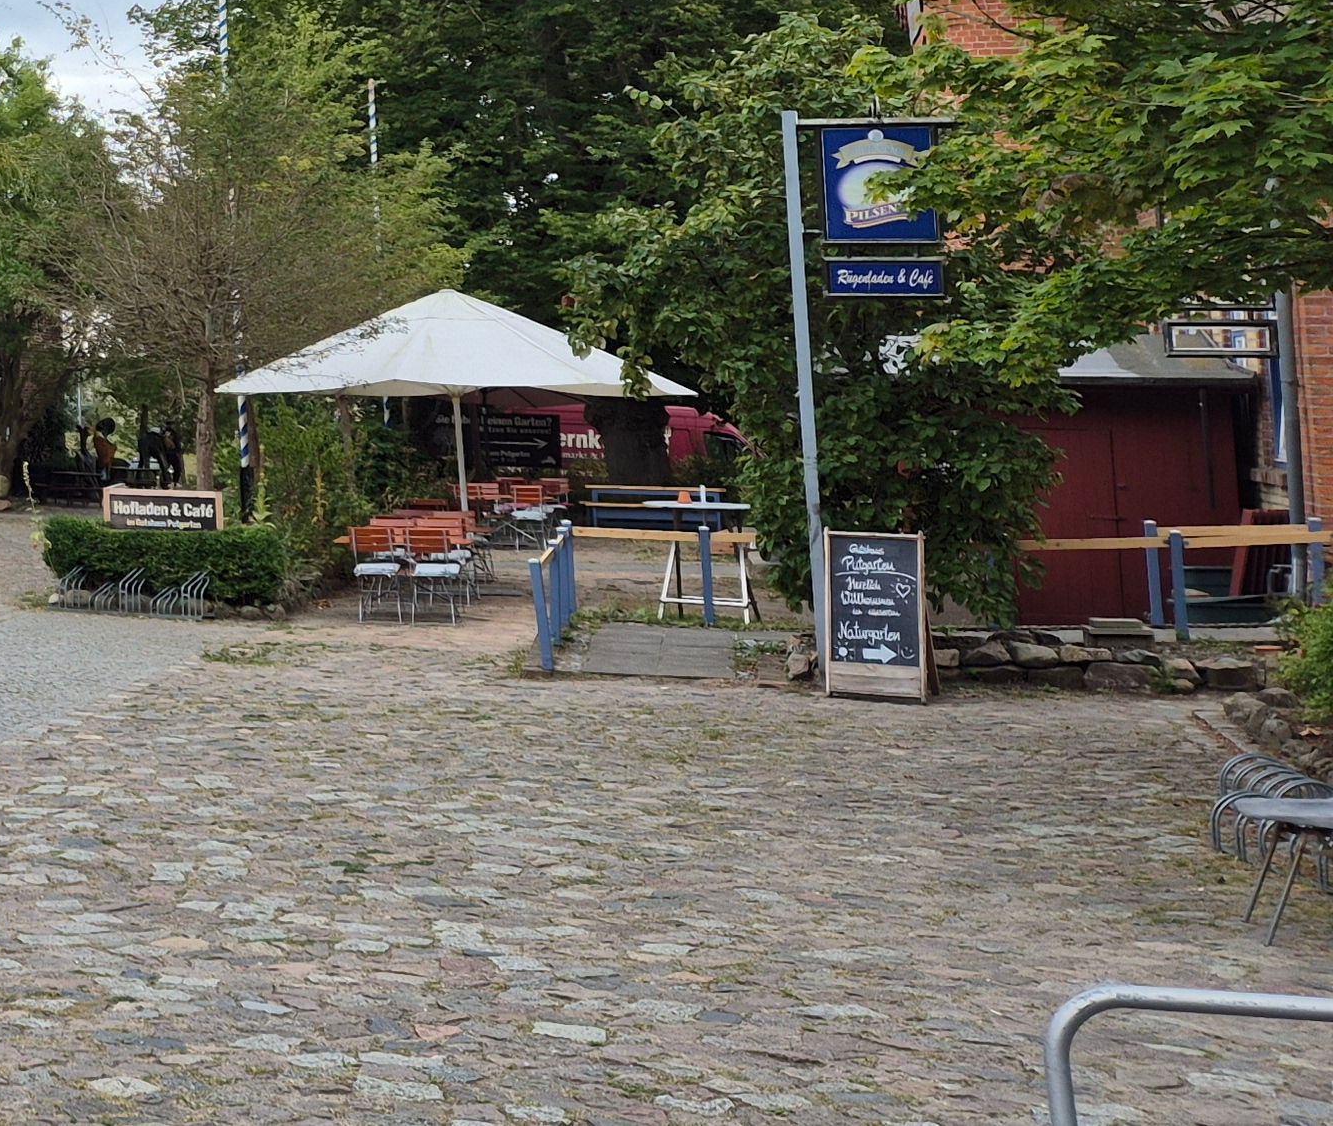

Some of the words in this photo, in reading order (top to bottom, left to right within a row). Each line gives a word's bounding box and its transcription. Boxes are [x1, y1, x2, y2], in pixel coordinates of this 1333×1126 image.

[844, 202, 903, 222] PILSEN
[837, 268, 894, 290] Rügenladen
[897, 268, 907, 285] &
[909, 268, 934, 290] Café
[559, 429, 605, 450] ernk
[112, 500, 169, 516] Hofladen
[170, 502, 182, 517] &
[183, 503, 214, 518] Café
[841, 555, 896, 575] Putgarten
[837, 620, 901, 646] Naturgarten
